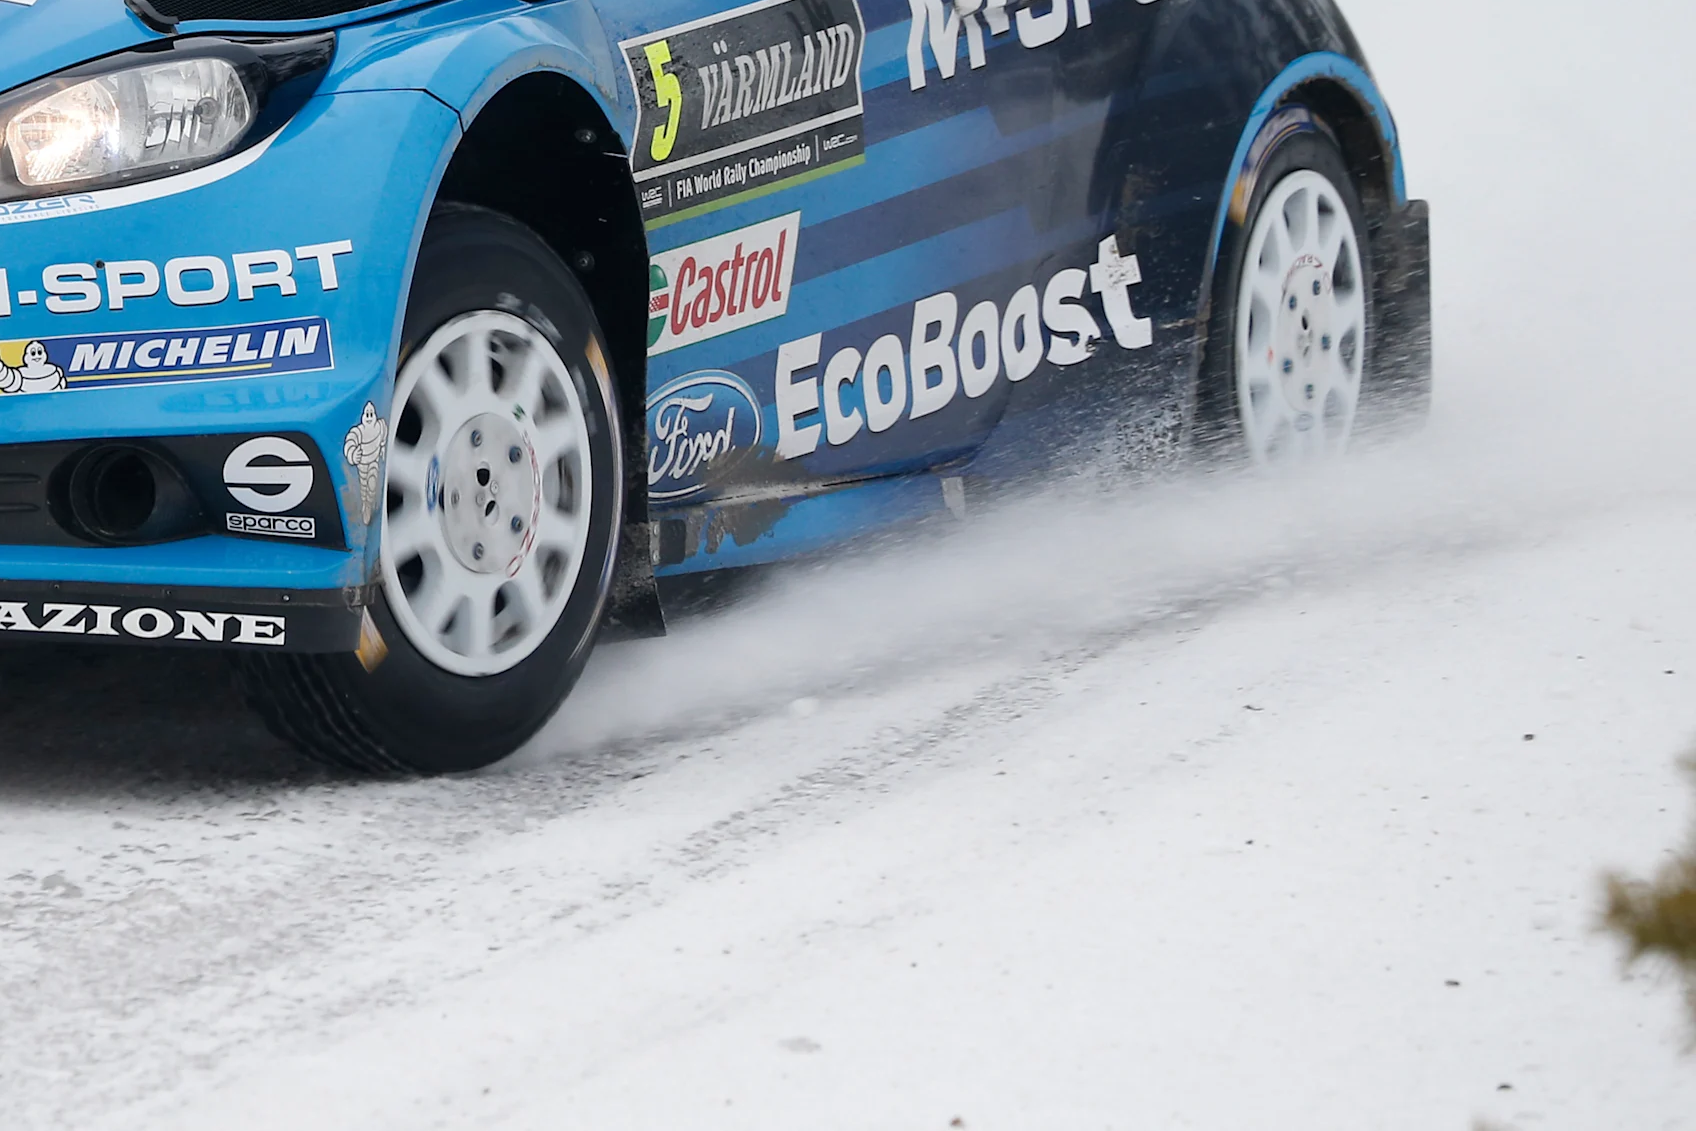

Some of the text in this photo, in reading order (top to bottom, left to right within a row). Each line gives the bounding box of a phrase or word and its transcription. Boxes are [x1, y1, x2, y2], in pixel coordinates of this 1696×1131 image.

[644, 23, 854, 162] 5 VÄRMLAND
[676, 179, 694, 200] FIA
[694, 169, 722, 193] World
[724, 162, 747, 185] Rally
[748, 143, 811, 178] Championship
[670, 228, 787, 336] Castrol
[67, 324, 322, 373] MICHELIN
[774, 233, 1152, 460] EcoBoost
[647, 392, 736, 486] Ford
[228, 514, 314, 532] sparco
